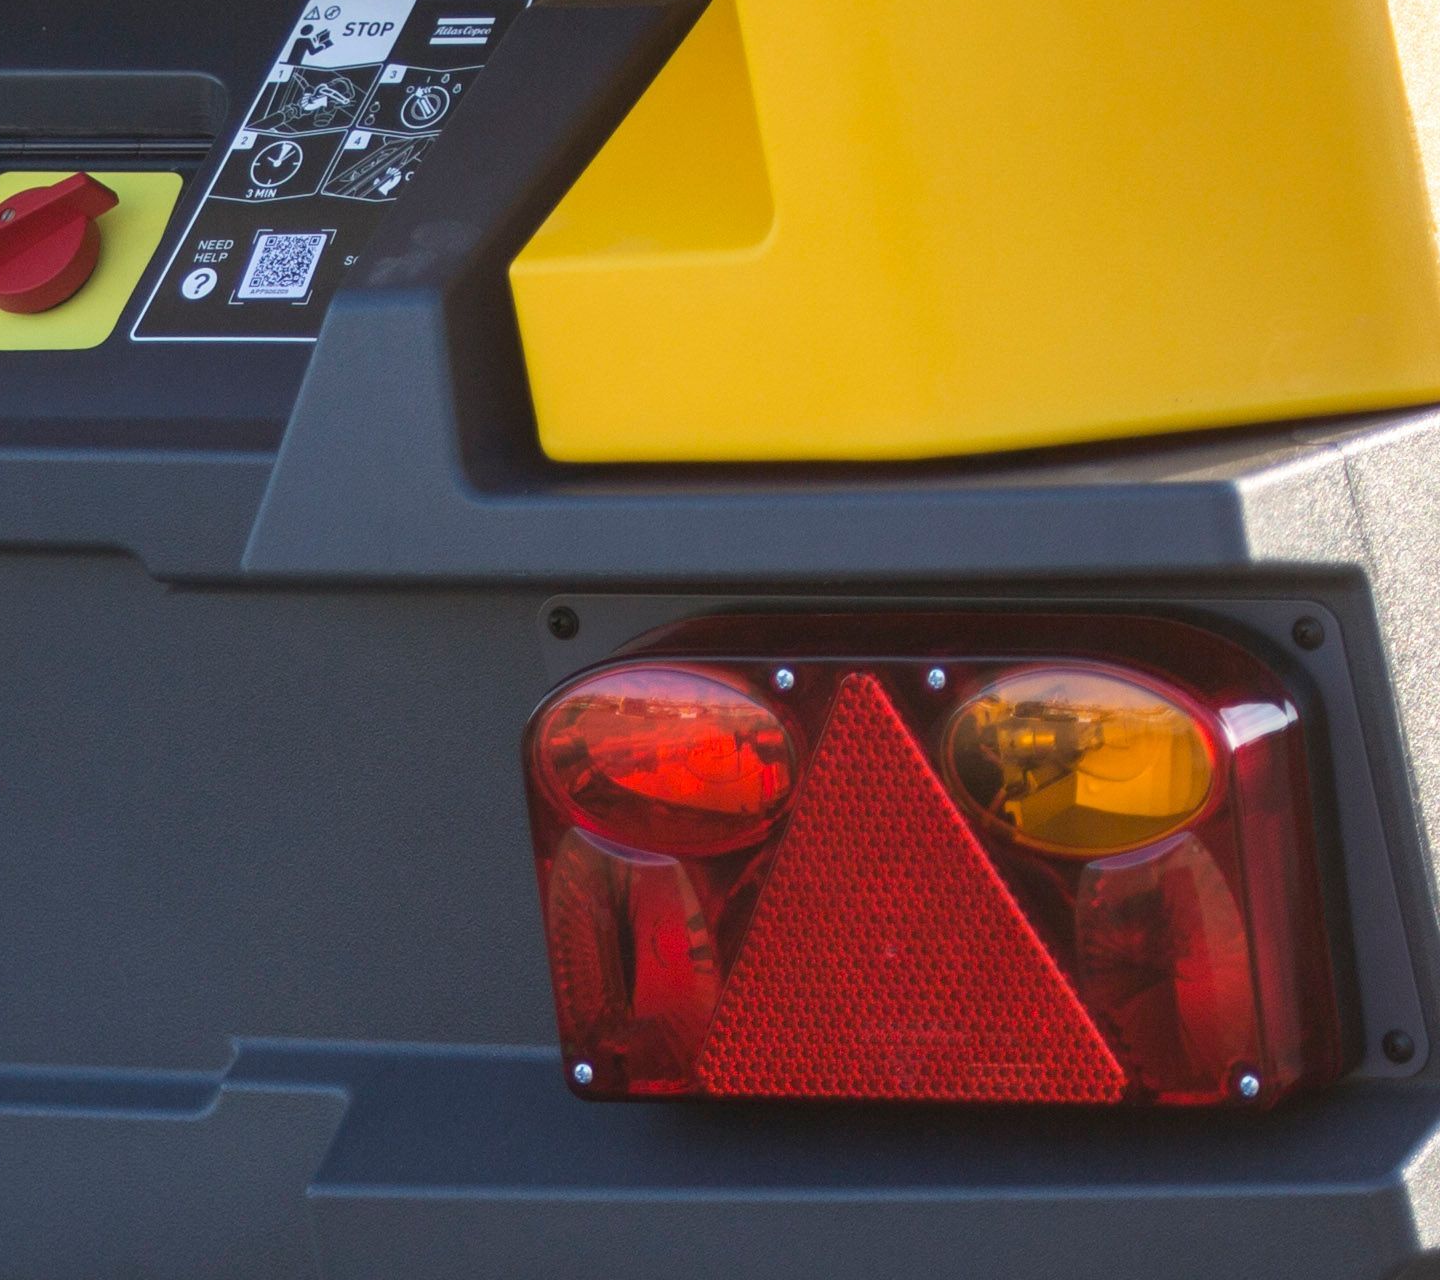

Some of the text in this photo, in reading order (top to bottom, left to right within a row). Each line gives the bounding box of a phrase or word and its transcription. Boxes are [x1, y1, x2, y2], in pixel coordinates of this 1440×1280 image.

[342, 21, 395, 38] STOP
[433, 25, 492, 37] Atlas Copco
[389, 70, 398, 79] 3
[240, 137, 249, 146] 2
[353, 137, 363, 146] 4
[245, 189, 278, 199] 3 MIN
[197, 239, 234, 251] NEED
[193, 252, 229, 263] HELP
